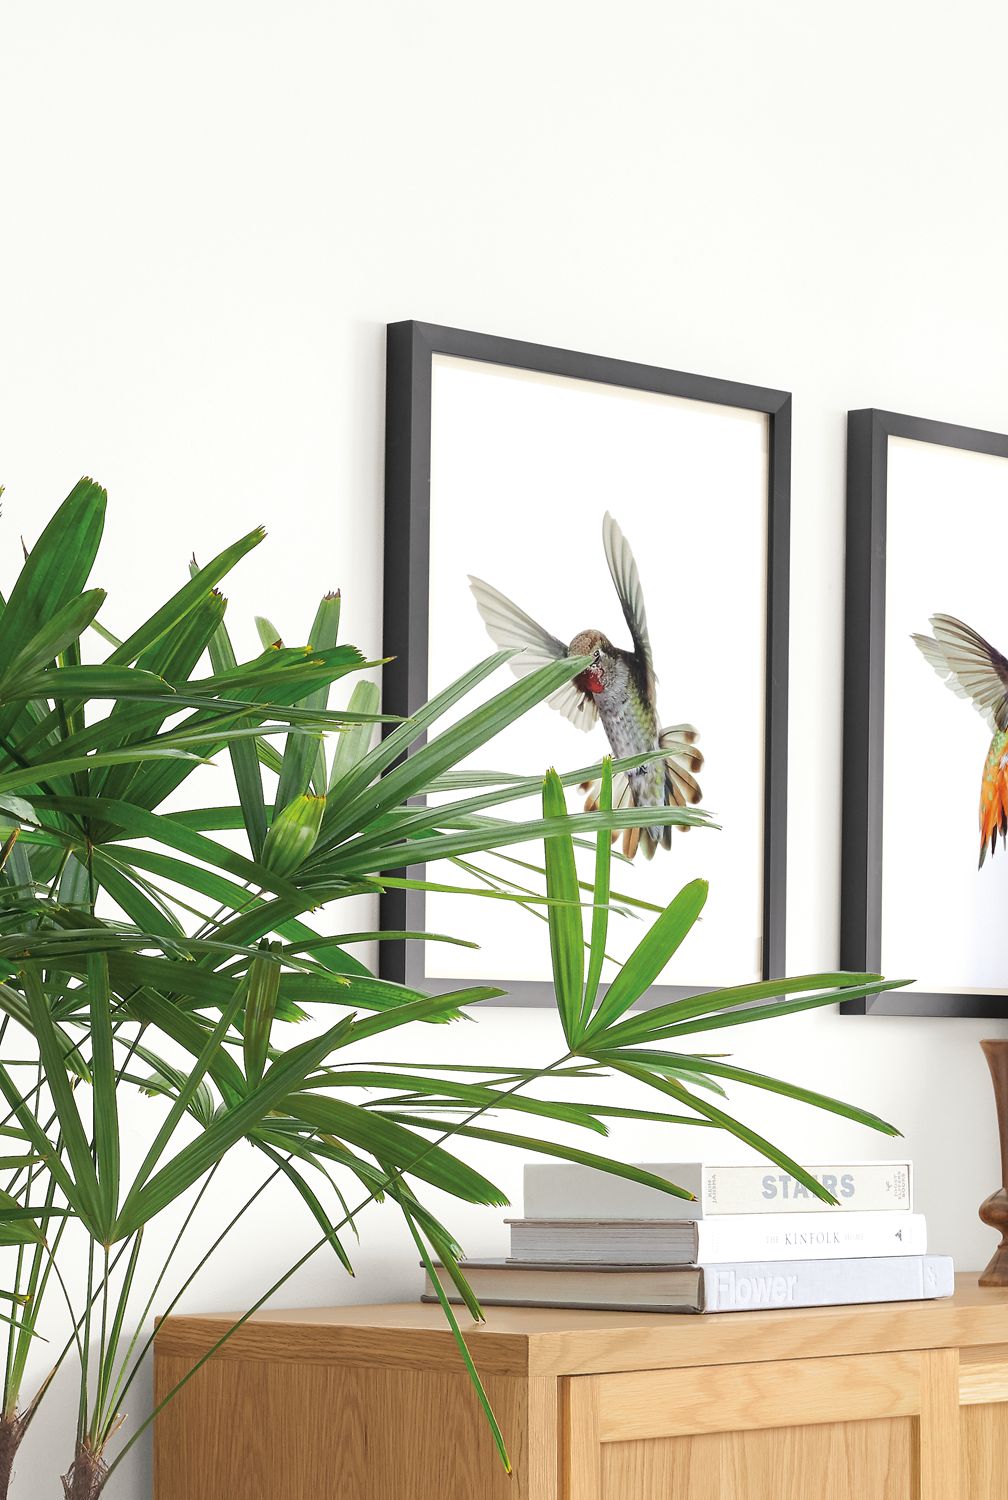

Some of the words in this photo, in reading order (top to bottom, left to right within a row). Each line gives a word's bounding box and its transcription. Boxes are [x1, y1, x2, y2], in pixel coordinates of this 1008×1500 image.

[761, 1174, 855, 1200] STARS
[785, 1232, 841, 1246] KINFOLK
[717, 1270, 798, 1305] Flower
